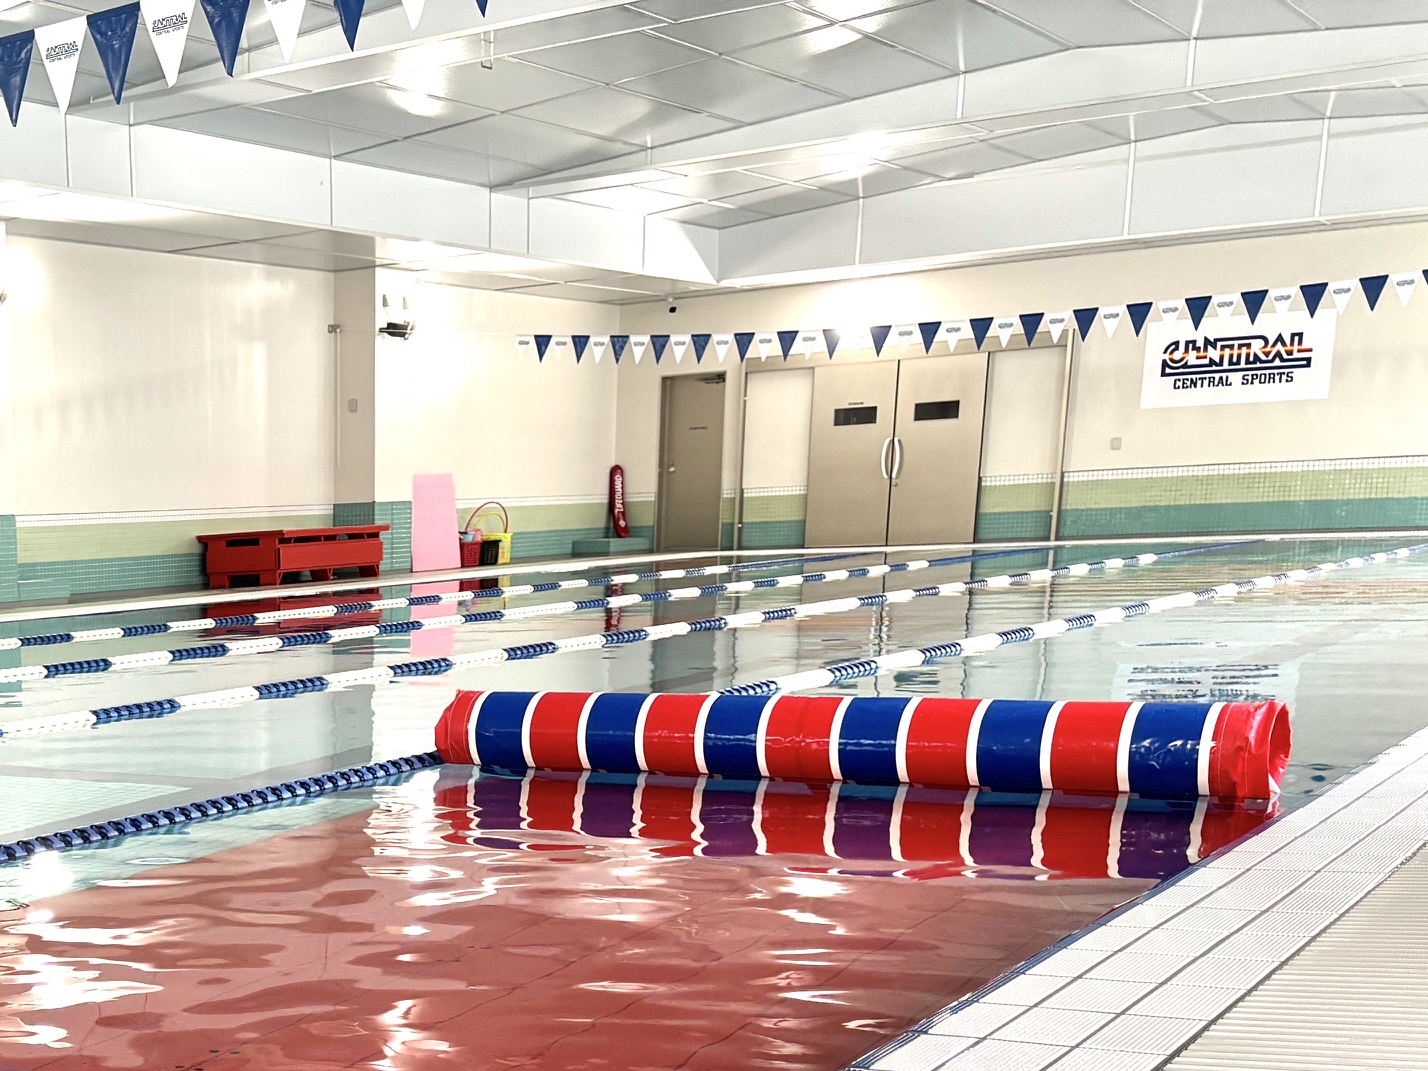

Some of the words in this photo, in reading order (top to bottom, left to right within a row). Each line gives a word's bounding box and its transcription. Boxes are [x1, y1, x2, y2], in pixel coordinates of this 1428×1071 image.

[1161, 331, 1313, 377] CENTRAL
[1173, 374, 1232, 390] CENTRAL
[1241, 371, 1294, 386] SPORTS
